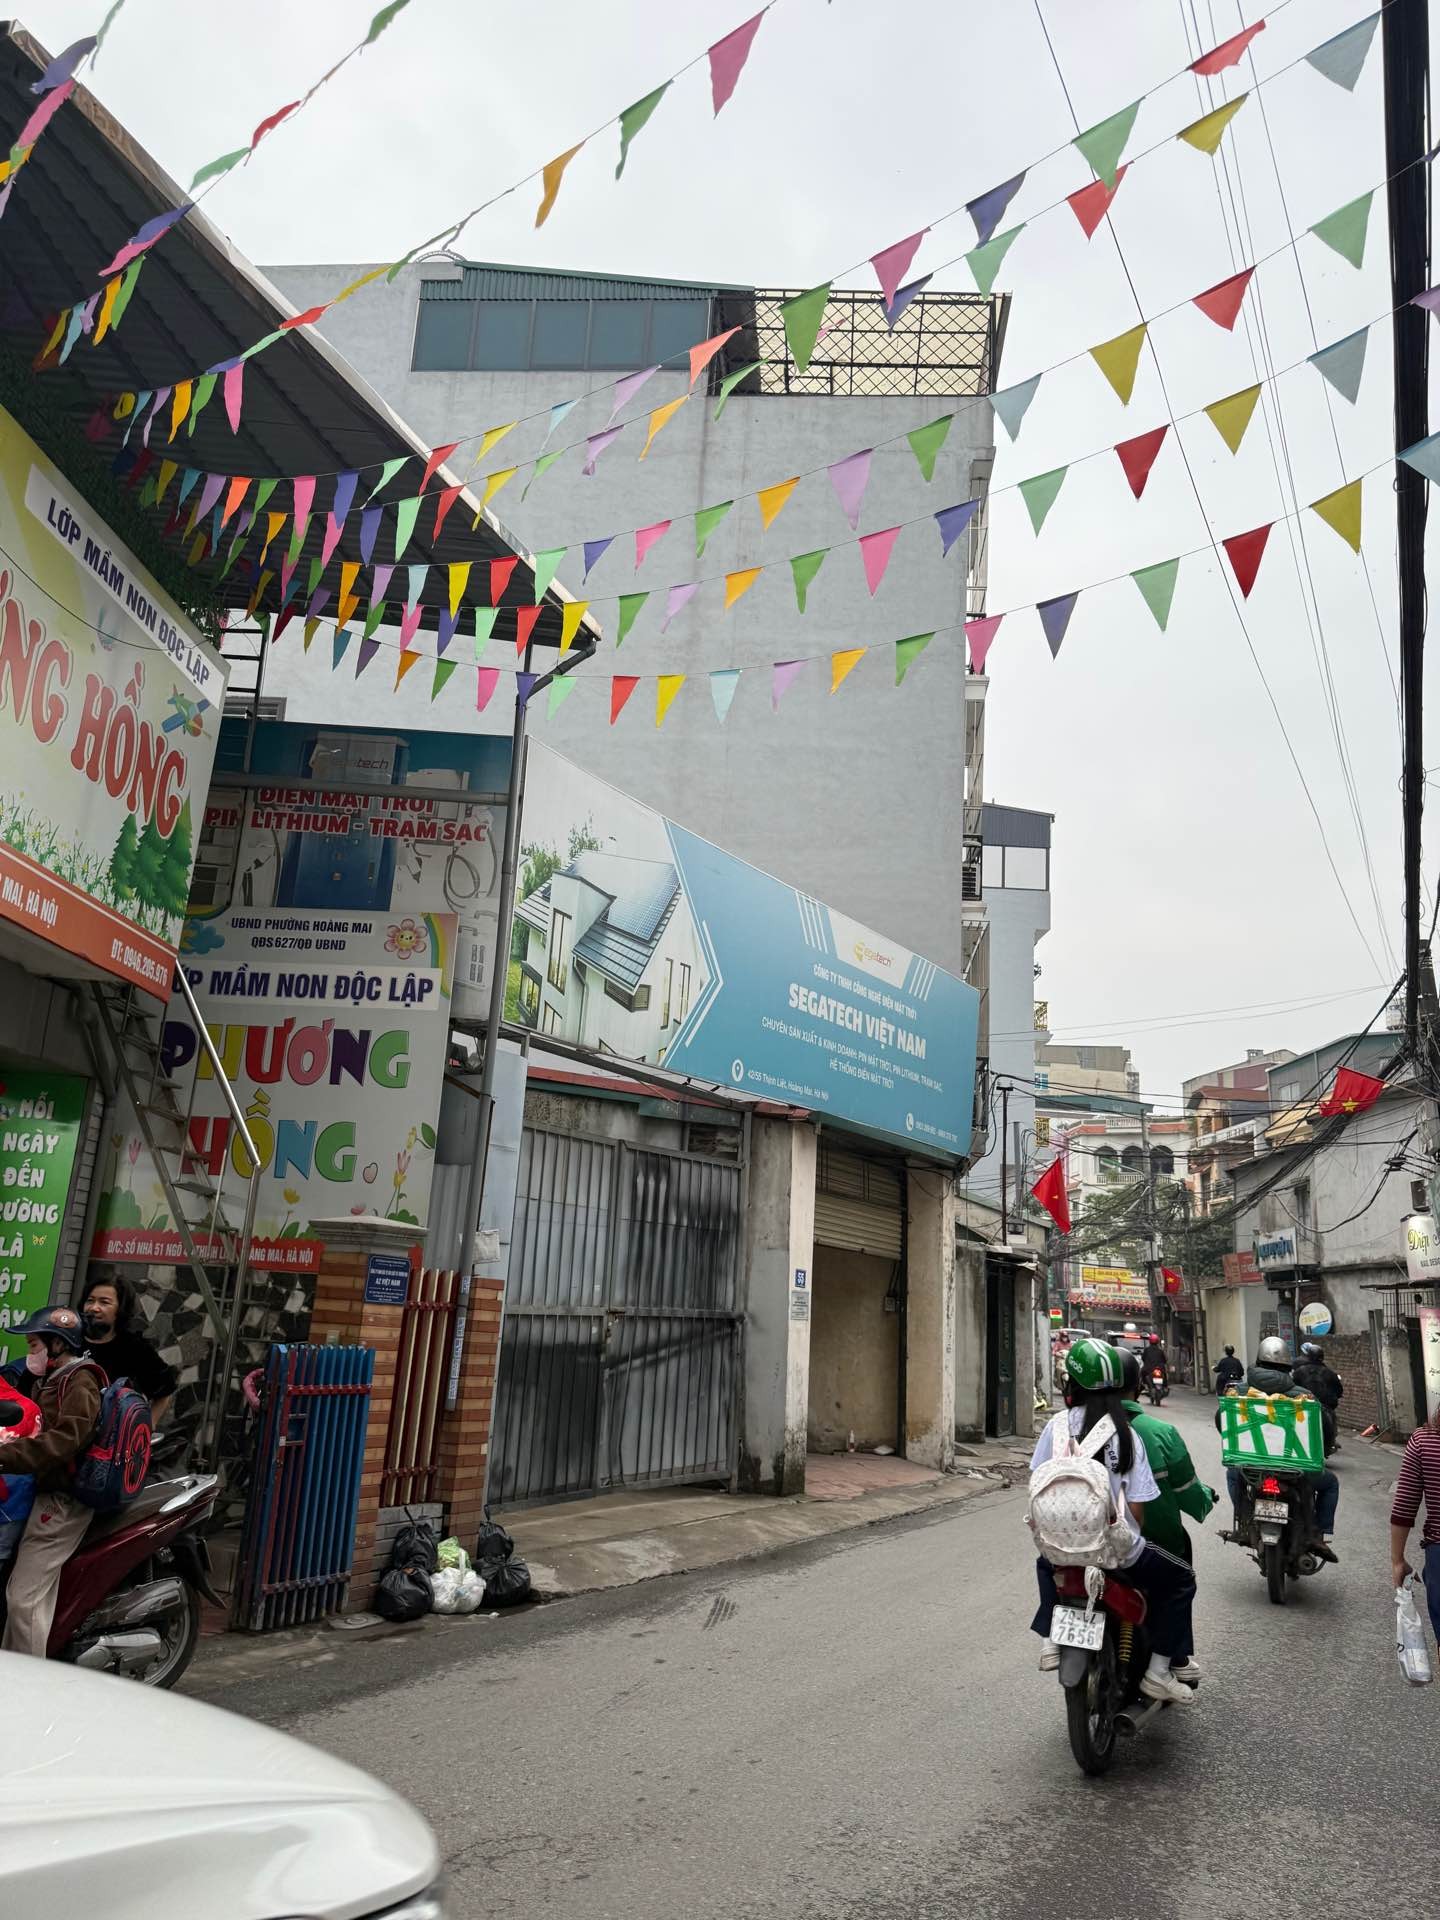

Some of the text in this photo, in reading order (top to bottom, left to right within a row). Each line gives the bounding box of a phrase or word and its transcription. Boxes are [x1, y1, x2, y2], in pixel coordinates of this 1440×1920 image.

[47, 497, 210, 686] LỚP MẦM NON ĐỘC LẬP
[250, 810, 350, 834] LITHIUM
[369, 818, 437, 843] TRẠM
[442, 822, 488, 846] SẠC
[26, 888, 41, 917] HÀ
[41, 899, 60, 929] NỘI
[231, 916, 373, 934] UBND PHƯỜNG HOÀNG MAI
[315, 939, 346, 951] UBND
[208, 963, 270, 997] MẦM
[276, 972, 329, 1000] NON
[333, 970, 382, 1006] ĐỘC
[388, 973, 434, 1008] LẬP
[761, 1016, 788, 1036] CHUYÊN
[788, 982, 927, 1060] SEGATECH VIỆT NAM
[161, 1016, 411, 1089] PHƯƠNG
[19, 1090, 55, 1120] MỖI
[2, 1129, 60, 1155] NGÀY
[180, 1087, 359, 1184] HỒNG
[2, 1158, 46, 1189] ĐẾN
[124, 1236, 136, 1255] SỐ
[136, 1239, 153, 1256] NHÀ
[153, 1242, 165, 1257] 51
[267, 1247, 285, 1264] MAI,
[286, 1246, 297, 1263] HÀ
[299, 1246, 314, 1267] NỘI
[1068, 1355, 1083, 1374] Grab
[1057, 1625, 1095, 1646] 7656
